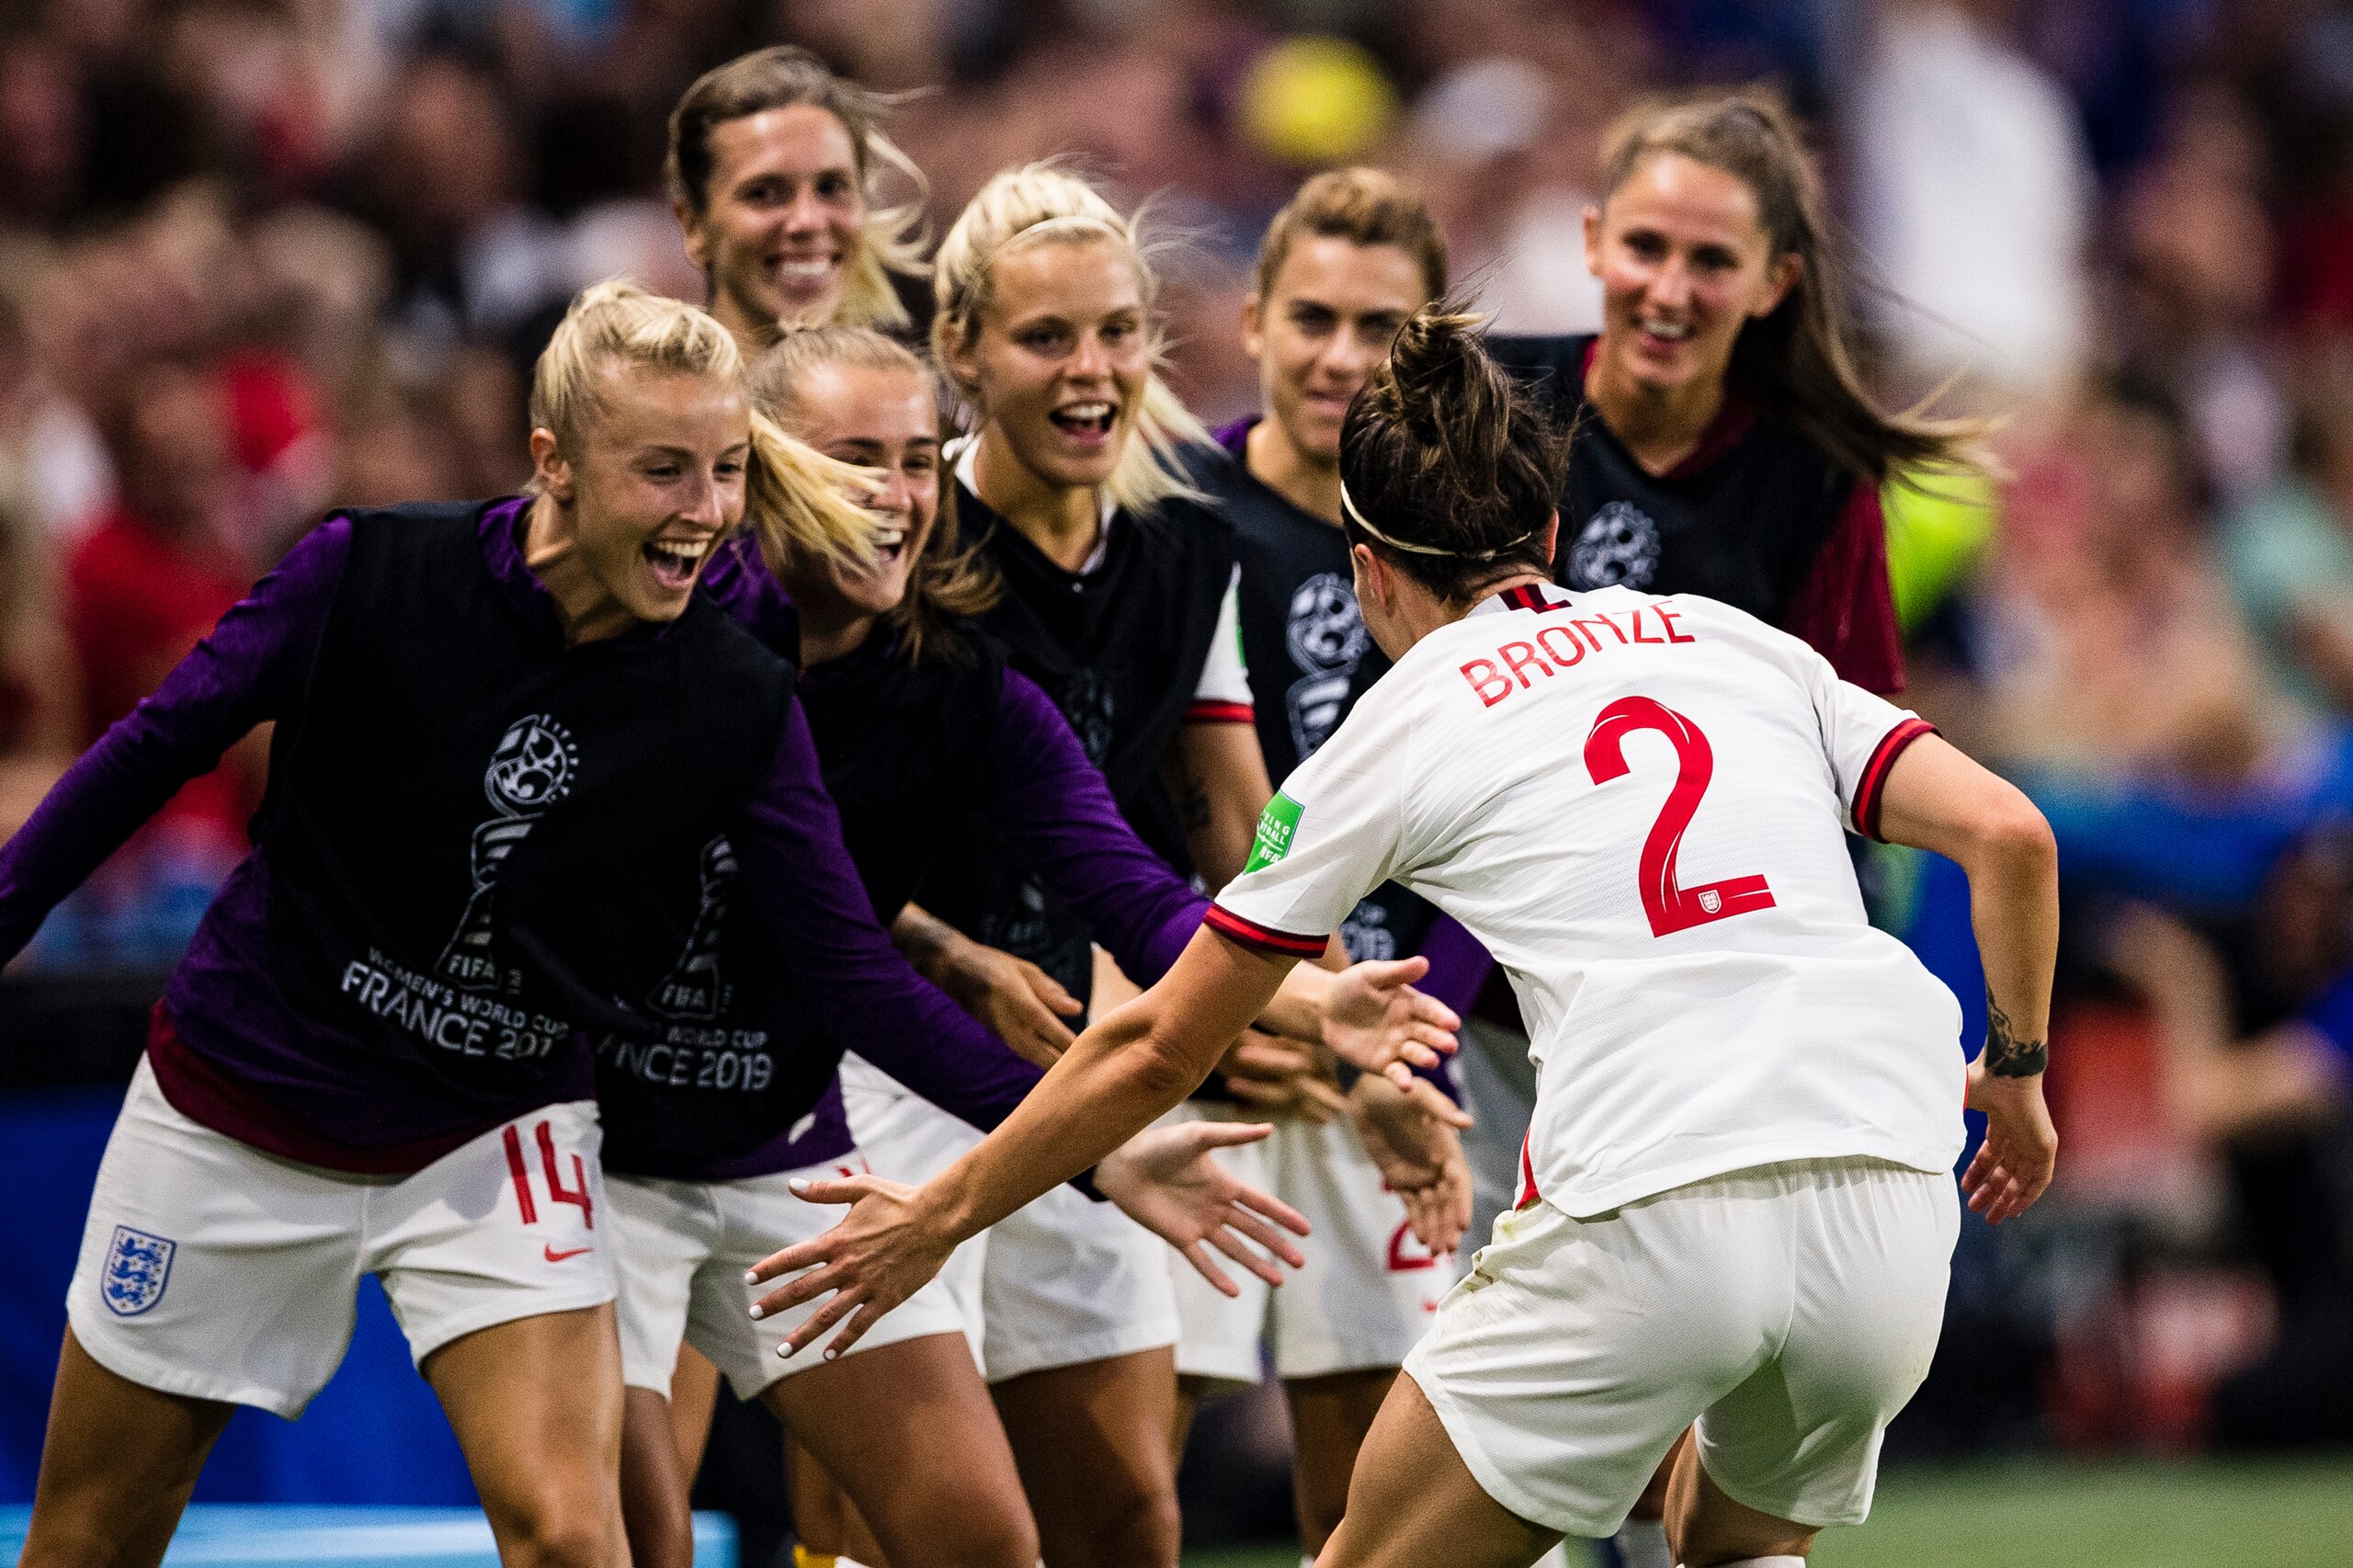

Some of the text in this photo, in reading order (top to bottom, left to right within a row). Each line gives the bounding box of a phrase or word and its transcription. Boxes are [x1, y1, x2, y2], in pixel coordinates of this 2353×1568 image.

[1459, 600, 1695, 708] BRONZE
[1584, 695, 1777, 938] 2
[340, 960, 491, 1057] FRANCE
[494, 1028, 555, 1062] 201
[449, 952, 496, 982] FIFA
[460, 993, 528, 1030] WORLD
[696, 1049, 776, 1092] 2019
[502, 1120, 594, 1230] 14
